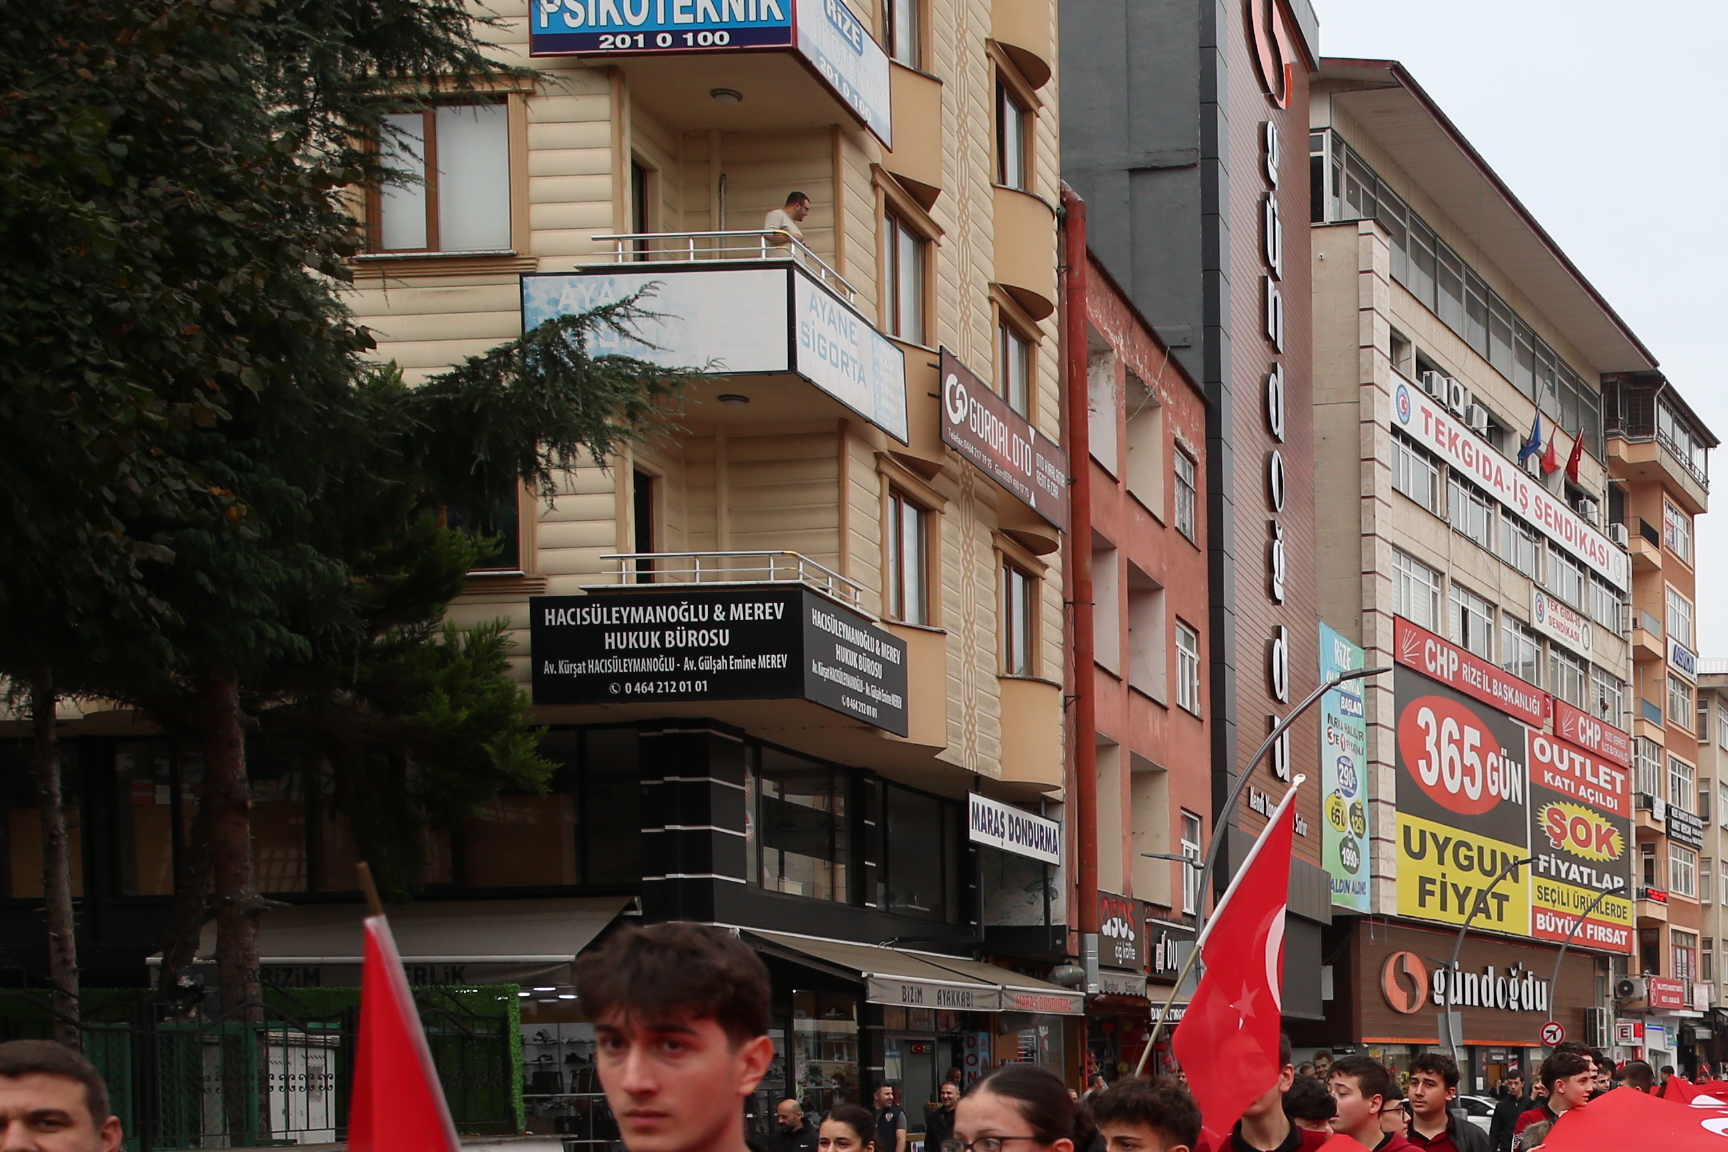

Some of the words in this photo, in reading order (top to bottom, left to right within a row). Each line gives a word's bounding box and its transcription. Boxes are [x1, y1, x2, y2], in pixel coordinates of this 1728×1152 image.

[599, 34, 645, 49] 201
[656, 33, 672, 48] 0
[682, 30, 730, 46] 100
[820, 57, 839, 87] 201
[853, 95, 872, 121] 100
[810, 291, 858, 347] AYANE
[801, 319, 868, 390] SİGORTA
[1012, 433, 1032, 477] OTO
[1421, 405, 1529, 515] TEKGIDA-İŞ
[1534, 495, 1610, 571] SENDİKASI
[544, 601, 709, 626] HACISÜLEYMANOĞLU
[713, 604, 726, 621] &
[729, 602, 785, 621] MEREV
[604, 631, 661, 650] HUKUK
[665, 626, 730, 648] BÜROSU
[881, 641, 901, 665] MEREV
[1334, 638, 1352, 671] RİZE
[544, 660, 557, 675] Av.
[558, 658, 587, 677] Kürşat
[588, 655, 675, 674] HACISÜLEYMANOĞLU
[683, 656, 697, 671] Av.
[698, 655, 728, 674] Gülşah
[729, 655, 757, 671] Emine
[758, 654, 788, 669] MEREV
[835, 643, 858, 669] HUKUK
[859, 652, 882, 680] BÜROSU
[1425, 638, 1458, 682] CHP
[1462, 661, 1482, 688] RİZE
[1482, 669, 1491, 693] İL
[1492, 679, 1540, 718] BAŞKANLIĞI
[625, 682, 632, 694] 0
[634, 682, 655, 694] 464
[657, 681, 677, 693] 212
[679, 681, 692, 692] 01
[695, 680, 708, 692] 01
[1578, 715, 1602, 750] CHP
[1417, 706, 1483, 801] 365
[1487, 748, 1523, 805] GÜN
[1533, 737, 1625, 795] OUTLET
[1544, 770, 1575, 794] KATI
[1578, 784, 1619, 811] AÇILDI
[971, 801, 1006, 848] MARAŞ
[1008, 813, 1059, 856] DONDURMA
[1545, 806, 1619, 860] ŞOK
[1403, 824, 1519, 884] UYGUN
[1418, 873, 1510, 922] FİYAT
[1536, 885, 1570, 909] SEÇİLİ
[1573, 890, 1628, 920] ÜRÜNLERDE
[1536, 912, 1584, 939] BÜYÜK
[1586, 923, 1629, 946] FIRSAT
[901, 985, 924, 1004] BİZİM
[937, 989, 975, 1008] AYAKKABI
[1433, 961, 1548, 1012] gündoğdu
